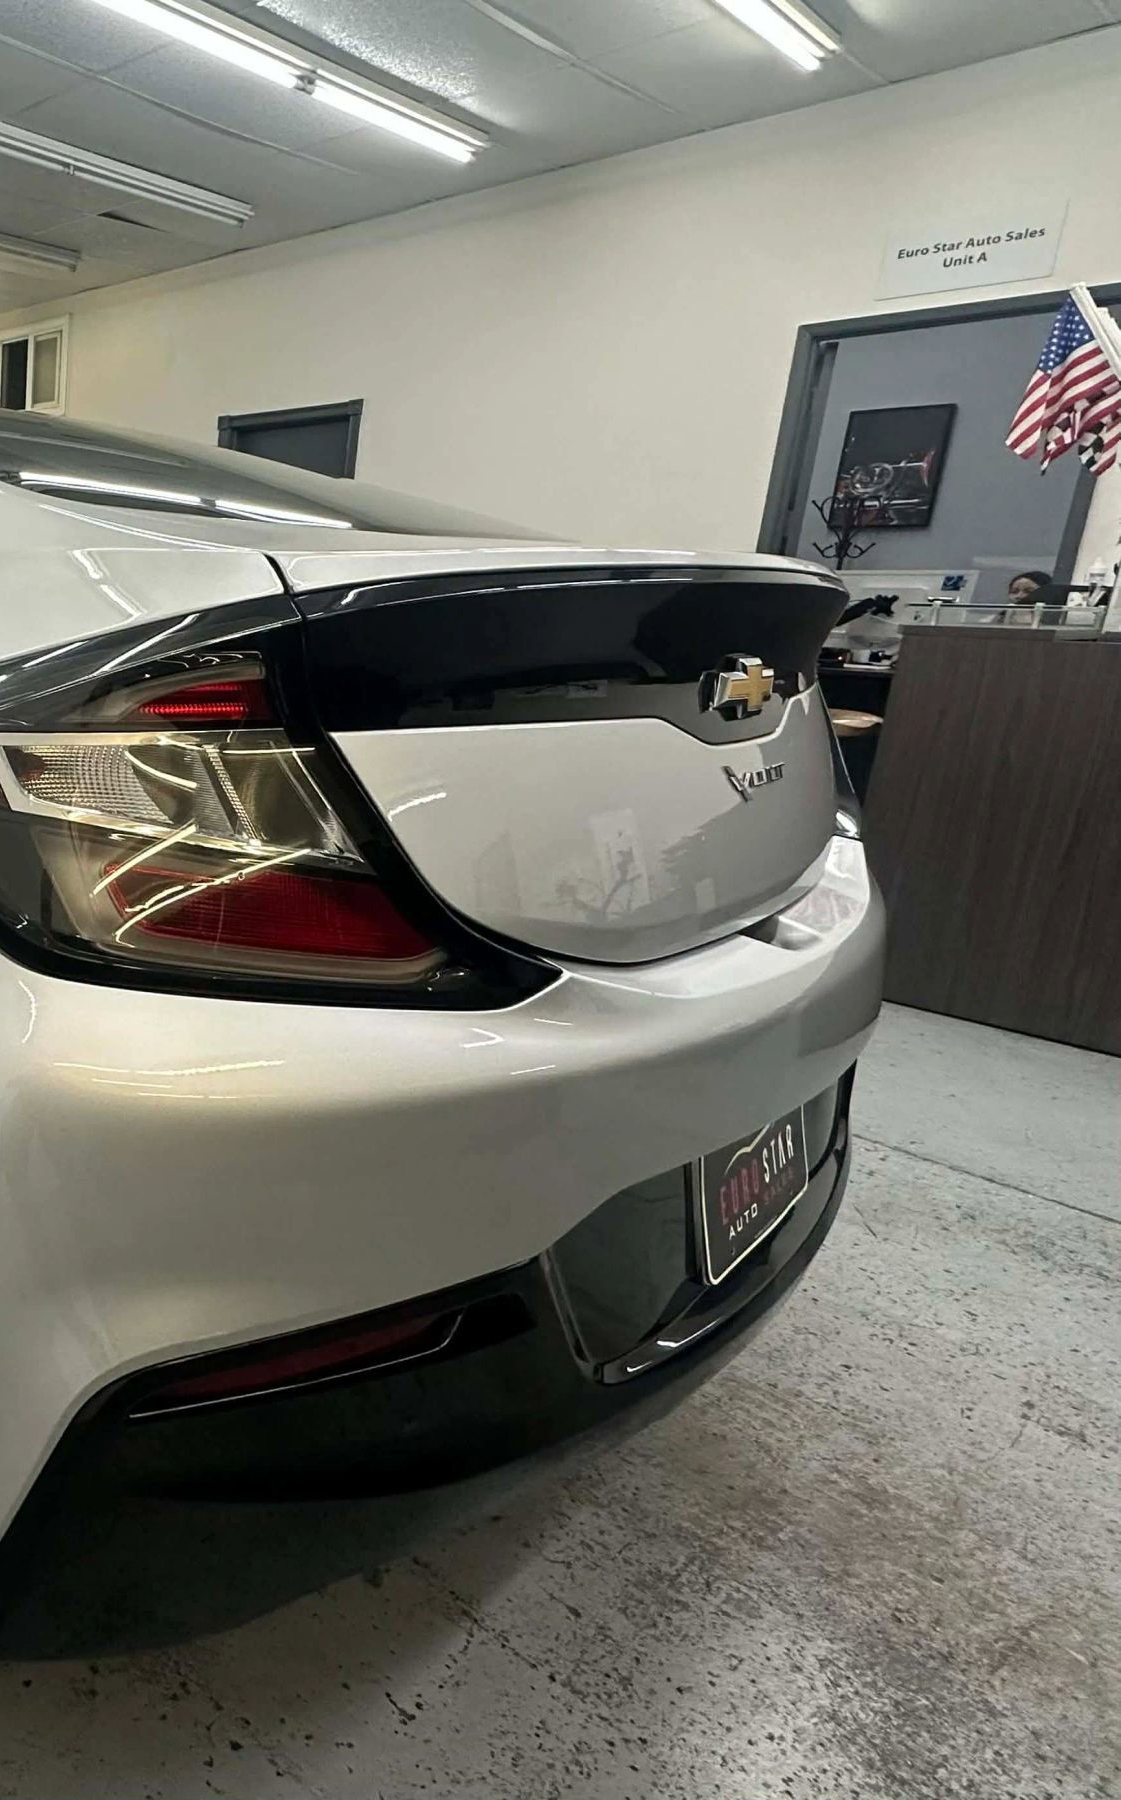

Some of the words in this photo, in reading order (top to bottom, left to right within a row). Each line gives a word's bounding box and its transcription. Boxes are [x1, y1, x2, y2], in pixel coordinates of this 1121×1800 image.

[897, 248, 930, 260] Euro
[933, 241, 963, 254] Star
[965, 235, 1002, 249] Auto
[1004, 227, 1046, 243] Sales
[942, 254, 974, 268] Unit
[976, 252, 988, 263] A
[721, 761, 786, 802] VOLT
[719, 1158, 761, 1226] EURO
[762, 1123, 795, 1184] STAR
[729, 1203, 759, 1241] AUTO
